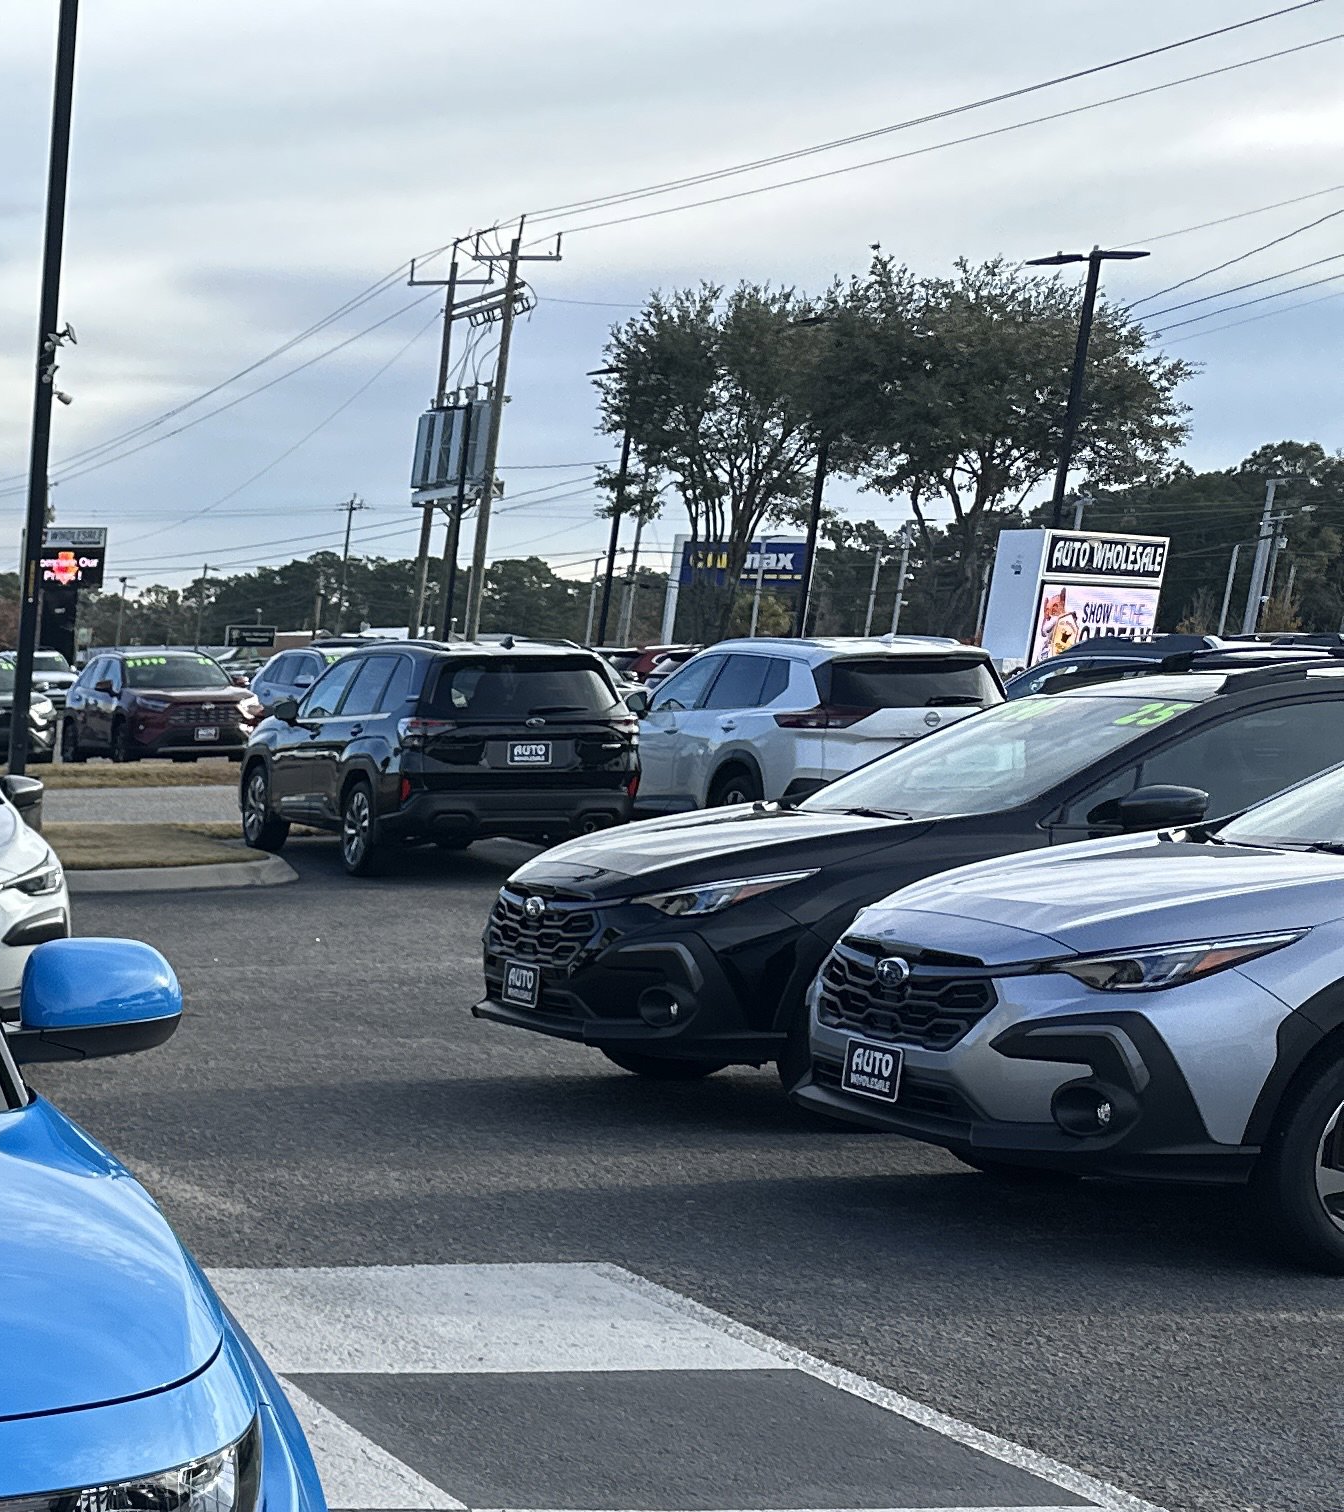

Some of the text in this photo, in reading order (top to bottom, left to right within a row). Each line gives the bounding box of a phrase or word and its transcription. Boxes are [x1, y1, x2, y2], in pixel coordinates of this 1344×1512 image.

[78, 556, 99, 568] Our
[1052, 540, 1164, 573] AUTO WHOLESALE
[1082, 602, 1113, 624] SHOW
[1113, 702, 1194, 727] 25
[514, 744, 546, 756] AUTO
[508, 967, 534, 989] AUTO
[852, 1047, 894, 1077] AUTO
